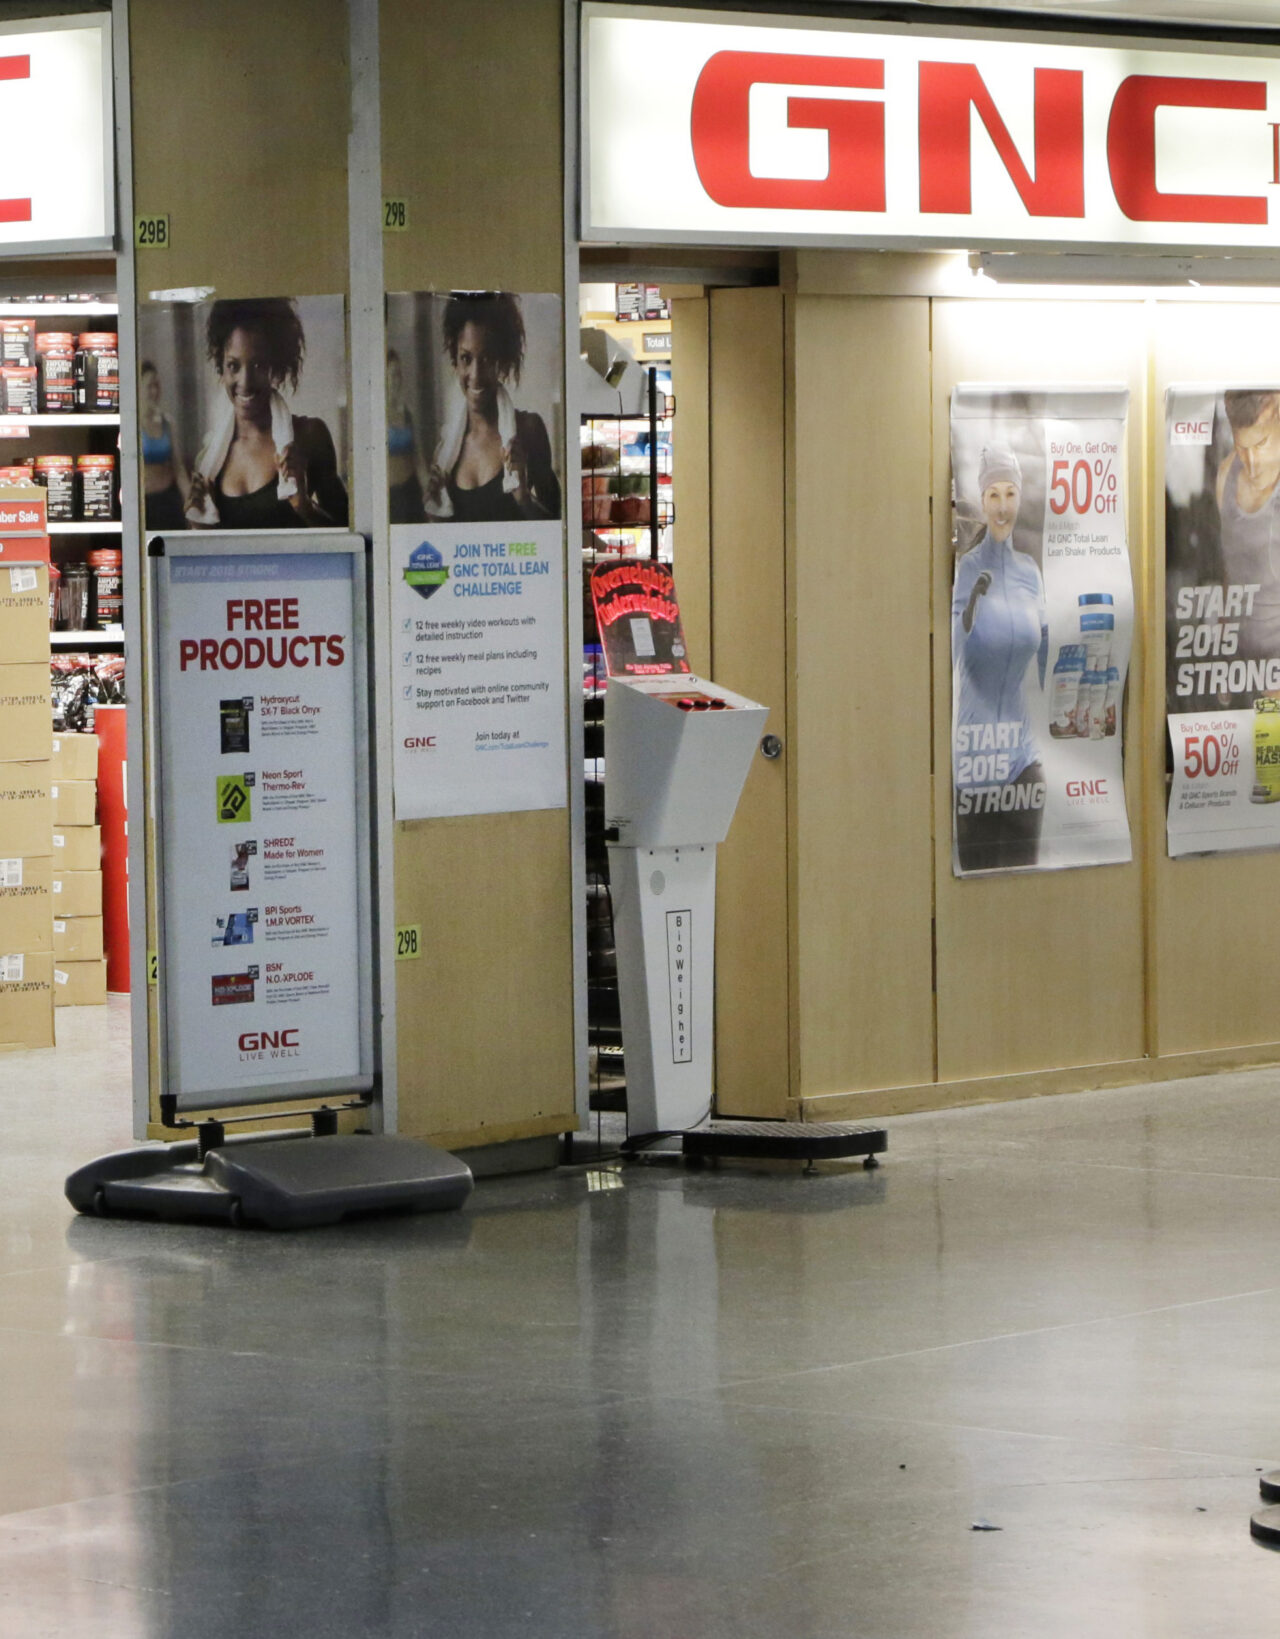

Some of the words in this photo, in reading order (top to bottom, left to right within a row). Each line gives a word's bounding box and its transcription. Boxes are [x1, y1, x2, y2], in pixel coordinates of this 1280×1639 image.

[691, 50, 1269, 225] GNC
[385, 201, 406, 227] 29B
[138, 219, 166, 244] 29B
[1175, 421, 1209, 434] GNC
[1050, 442, 1065, 455] Buy
[1085, 442, 1099, 454] Get
[1101, 442, 1118, 453] One
[1049, 458, 1117, 515] 50%
[1094, 494, 1118, 514] Off
[18, 511, 39, 523] Sale
[453, 543, 481, 558] JOIN
[483, 543, 506, 557] THE
[508, 542, 537, 556] FREE
[453, 564, 479, 577] GNC
[481, 562, 517, 576] TOTAL
[519, 561, 549, 575] LEAN
[453, 581, 522, 597] CHALLENGE
[1175, 584, 1261, 619] START
[227, 598, 300, 632] FREE
[415, 620, 423, 630] 12
[425, 620, 439, 630] free
[441, 619, 465, 630] weekly
[466, 618, 487, 628] video
[488, 617, 519, 627] workouts
[521, 616, 536, 626] with
[415, 632, 444, 642] detailed
[445, 631, 483, 640] instruction
[1175, 622, 1240, 658] 2015
[416, 655, 424, 664] 12
[425, 654, 440, 663] free
[441, 653, 465, 664] weekly
[467, 652, 484, 661] meal
[486, 651, 505, 661] plans
[506, 650, 537, 660] including
[416, 666, 442, 676] recipes
[1176, 658, 1280, 697] STRONG
[416, 687, 432, 698] Stay
[433, 686, 470, 696] motivated
[471, 685, 486, 694] with
[487, 683, 509, 693] online
[510, 682, 549, 693] community
[260, 695, 300, 705] Hydroxycut
[416, 700, 444, 710] support
[456, 695, 489, 706] Facebook
[491, 695, 505, 704] and
[506, 694, 530, 703] Twitter
[280, 705, 301, 715] Black
[302, 705, 321, 716] Onyx
[1180, 723, 1193, 733] Buy
[1211, 722, 1222, 731] Get
[1223, 721, 1237, 729] One
[404, 736, 436, 748] GNC
[475, 731, 490, 741] Join
[491, 730, 510, 741] today
[512, 730, 519, 739] at
[956, 720, 1024, 751] START
[1183, 733, 1239, 779] 50%
[262, 770, 282, 780] Neon
[283, 770, 303, 780] Sport
[957, 753, 1011, 784] 2015
[1221, 760, 1239, 776] Off
[262, 781, 305, 792] Thermo-Rev
[1066, 779, 1108, 797] GNC
[957, 782, 1046, 815] STRONG
[263, 837, 294, 848] SHREDZ
[264, 849, 284, 859] Made
[285, 849, 296, 858] for
[297, 848, 324, 858] Women
[265, 906, 278, 916] BPI
[279, 905, 302, 916] Sports
[285, 916, 314, 926] VORTEX
[397, 929, 418, 955] 29B
[266, 963, 282, 972] BSN
[238, 1028, 299, 1051] GNC
[239, 1053, 264, 1062] LIVE
[270, 1049, 300, 1059] WELL
